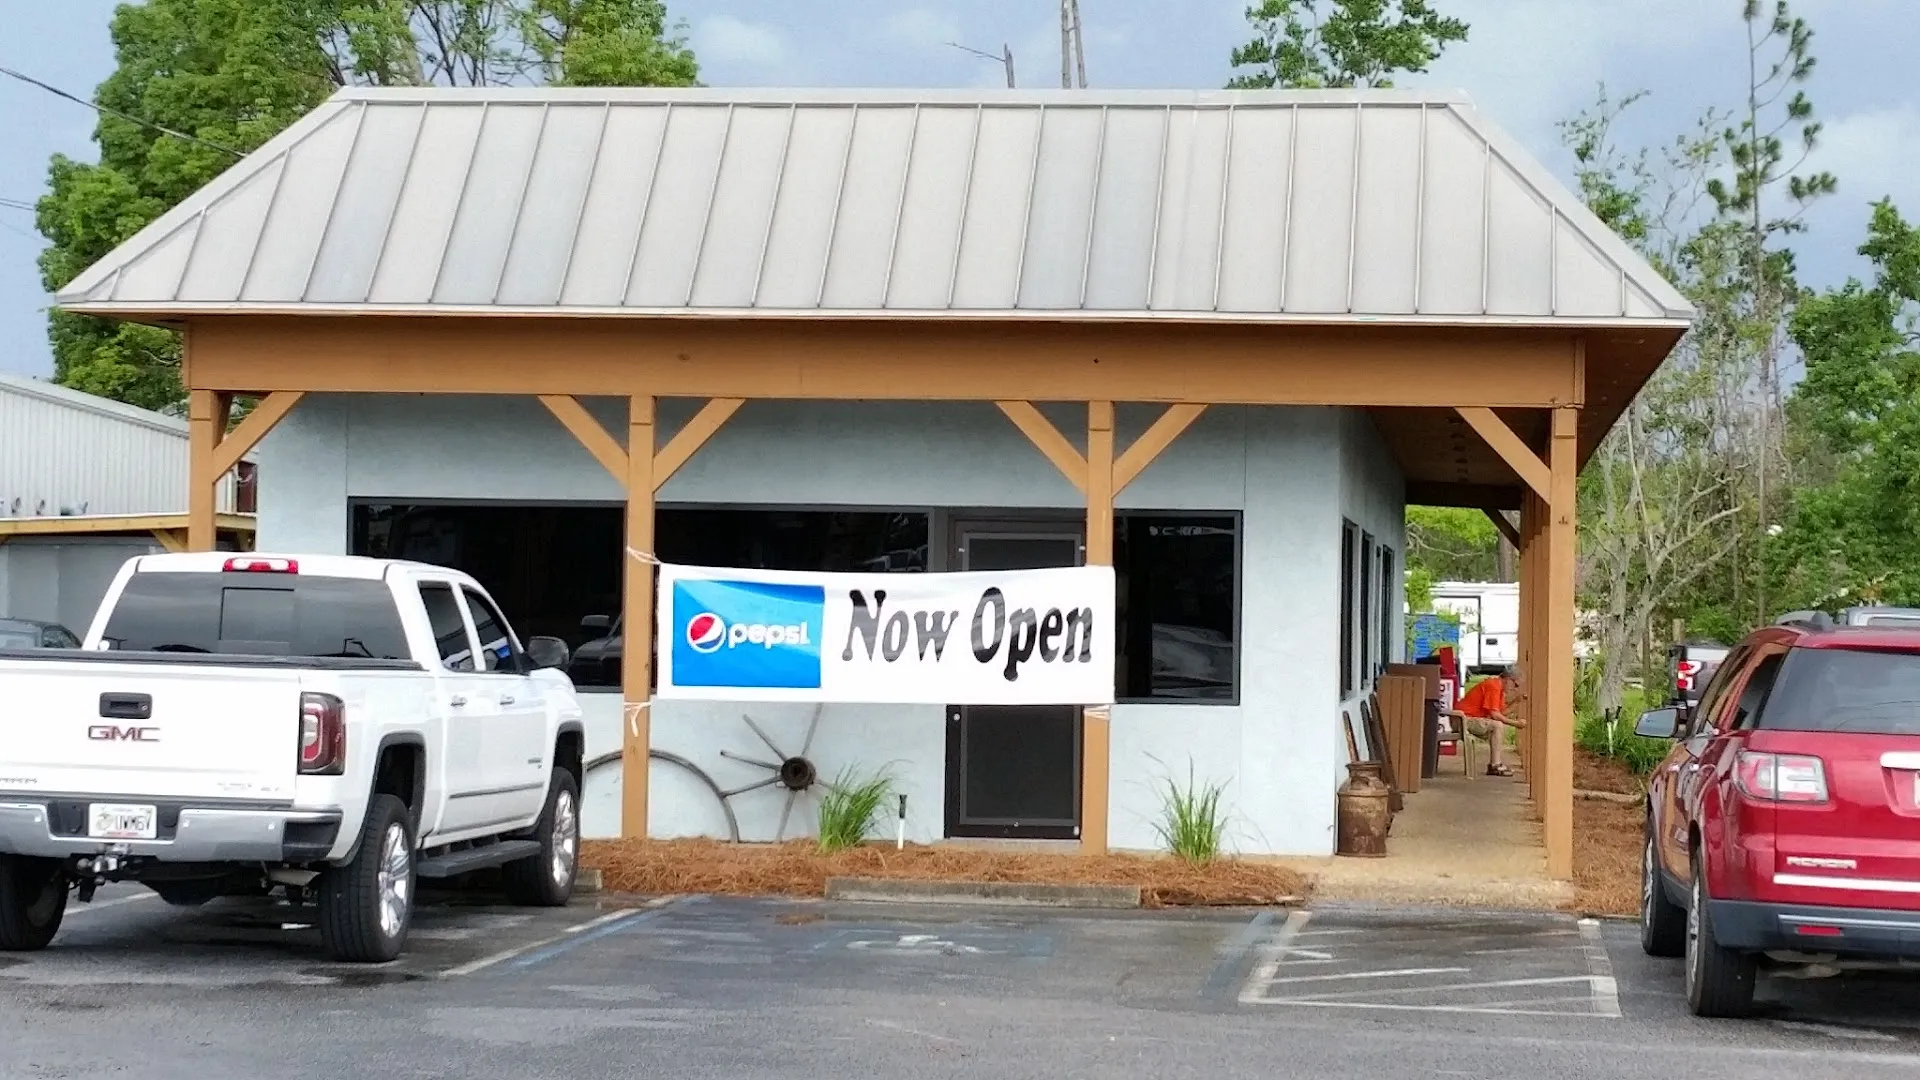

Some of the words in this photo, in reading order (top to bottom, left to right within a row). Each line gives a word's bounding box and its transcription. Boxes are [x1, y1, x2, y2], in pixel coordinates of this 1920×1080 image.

[728, 621, 810, 648] pepsi
[842, 589, 959, 663] Now
[970, 586, 1093, 681] Open
[88, 725, 161, 742] GMC
